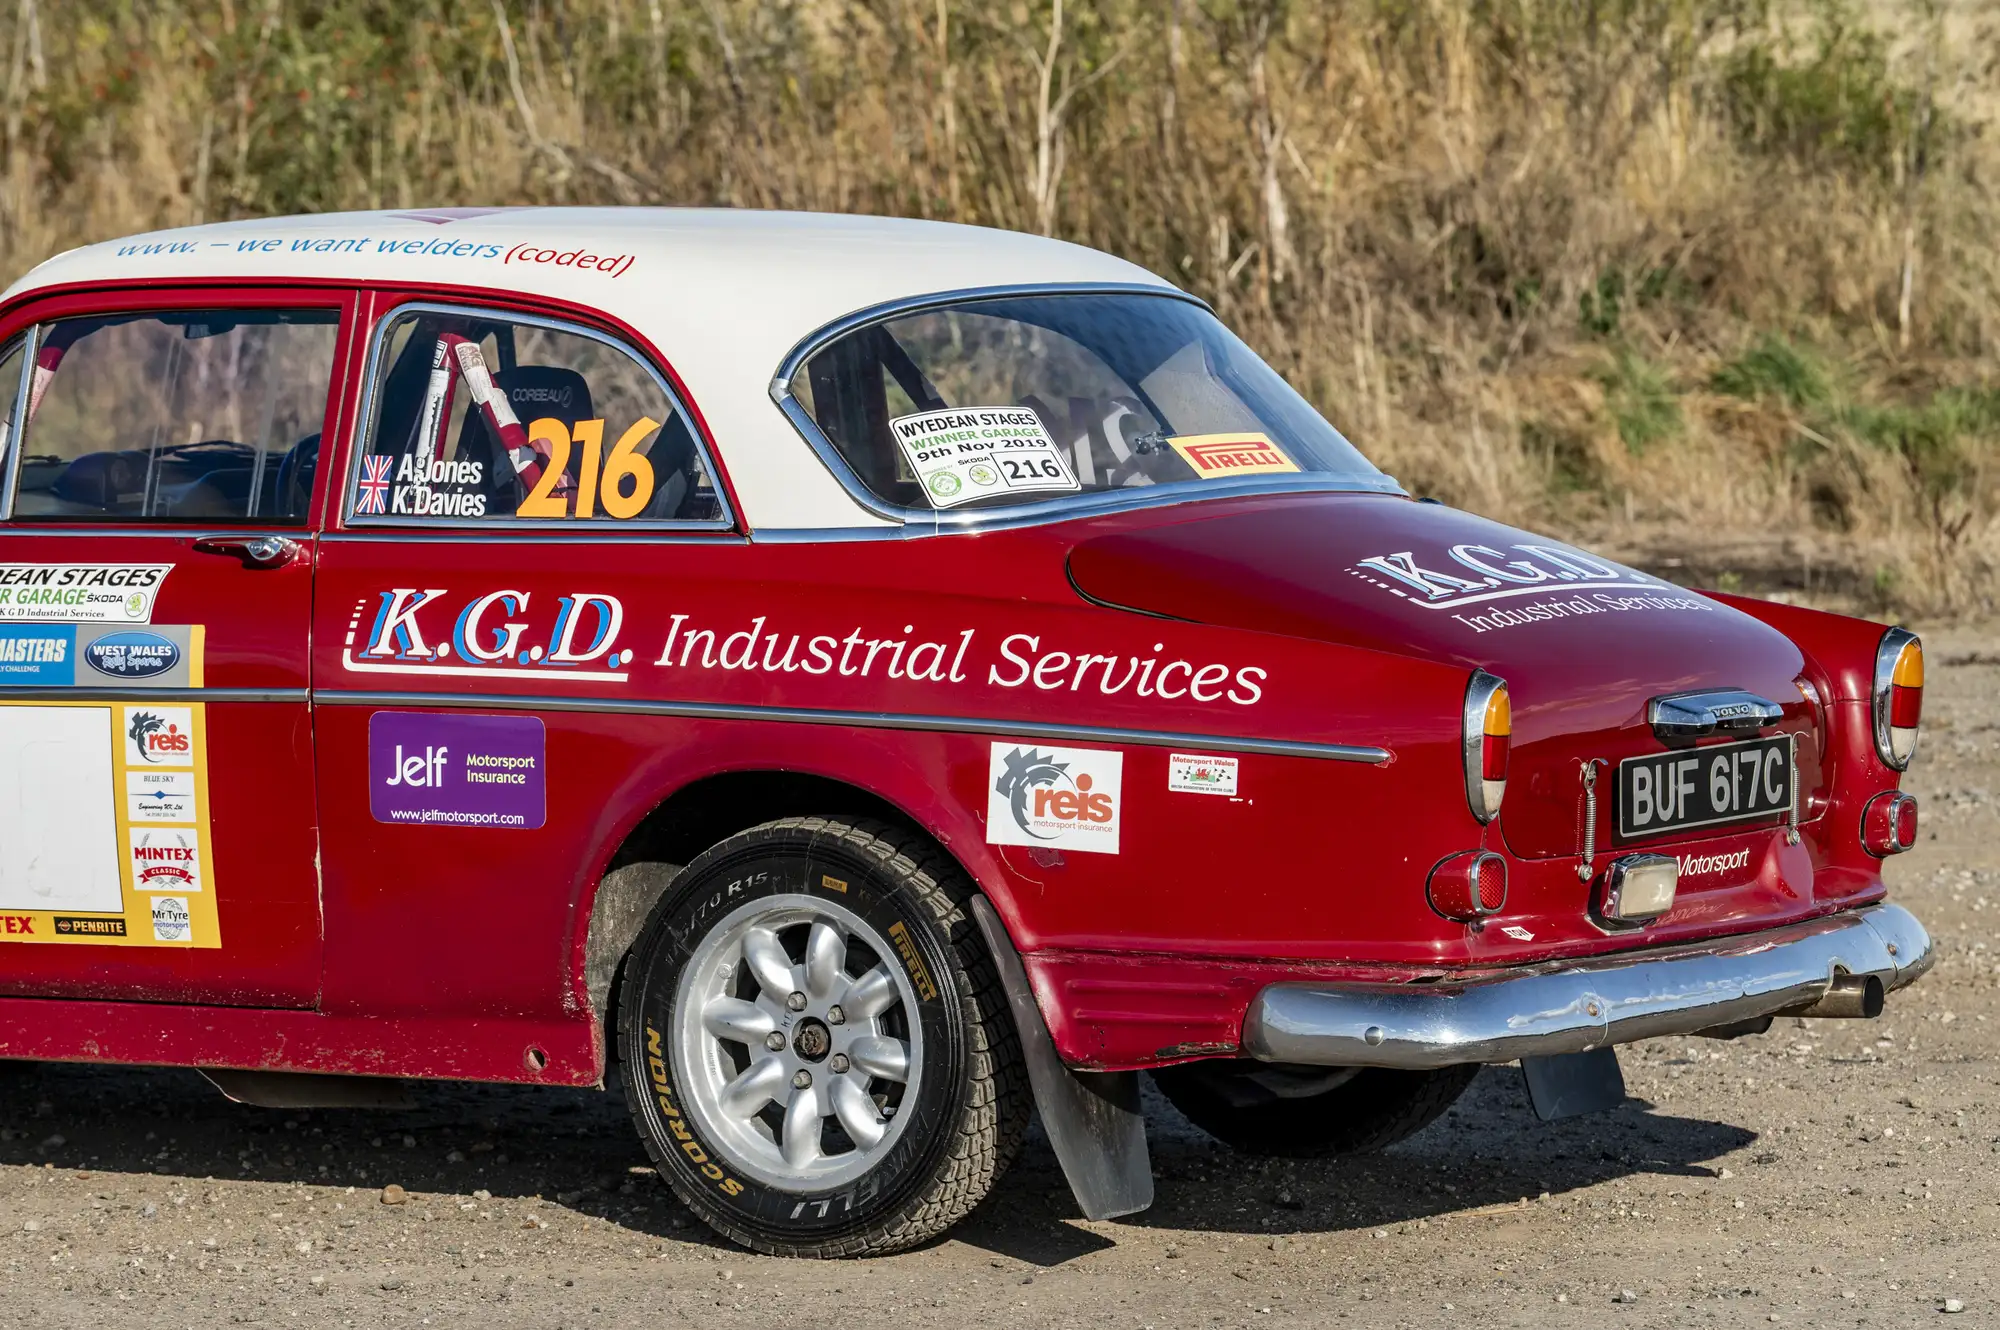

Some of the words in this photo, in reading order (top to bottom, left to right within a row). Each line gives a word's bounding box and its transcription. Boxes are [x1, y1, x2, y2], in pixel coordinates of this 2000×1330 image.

[117, 241, 197, 256] www.
[236, 238, 283, 253] we
[291, 237, 370, 253] want
[378, 238, 504, 258] welders
[503, 243, 636, 279] (coded)
[513, 389, 565, 405] CORBEAU
[898, 414, 979, 438] WYEDEAN
[979, 413, 1037, 426] STAGES
[908, 430, 977, 451] WINNER
[981, 428, 1043, 439] GARAGE
[917, 448, 952, 463] 9th
[958, 441, 995, 454] Nov
[1001, 439, 1047, 449] 2019
[1183, 441, 1285, 471] PIRELLI
[515, 416, 662, 519] 216
[1002, 458, 1061, 480] 216
[58, 568, 162, 587] STAGES
[16, 588, 88, 605] GARAGE
[86, 592, 123, 603] ŠKODA
[8, 608, 15, 616] G
[17, 608, 25, 616] D
[27, 608, 68, 617] Industrial
[70, 608, 105, 618] Services
[1451, 594, 1605, 633] Industrial
[1603, 592, 1713, 612] Services
[359, 588, 634, 669] K.G.D.
[93, 645, 126, 656] WEST
[130, 645, 172, 656] WALES
[654, 614, 976, 684] Industrial
[988, 633, 1268, 705] Services
[6, 665, 40, 673] CHALLENGE
[102, 653, 126, 672] Rally
[127, 653, 163, 671] Spares
[1713, 705, 1750, 717] VOLVO
[149, 724, 189, 751] reis
[386, 744, 449, 788] Jelf
[466, 753, 535, 771] Motorsport
[1172, 756, 1212, 765] Motorsport
[467, 770, 526, 785] Insurance
[1633, 758, 1699, 826] BUF
[1710, 747, 1783, 813] 617C
[1034, 773, 1113, 823] reis
[390, 808, 524, 826] www.jelfmotorsport.com
[1034, 820, 1076, 830] motorsport
[1077, 822, 1113, 832] insurance
[134, 847, 194, 861] MINTEX
[151, 868, 181, 876] CLASSIC
[728, 871, 769, 897] R15
[152, 910, 165, 919] Mr
[166, 910, 188, 922] Tyre
[72, 921, 124, 933] PENRITE
[888, 920, 937, 1002] PIRELLI
[647, 1028, 744, 1197] SCORPION
